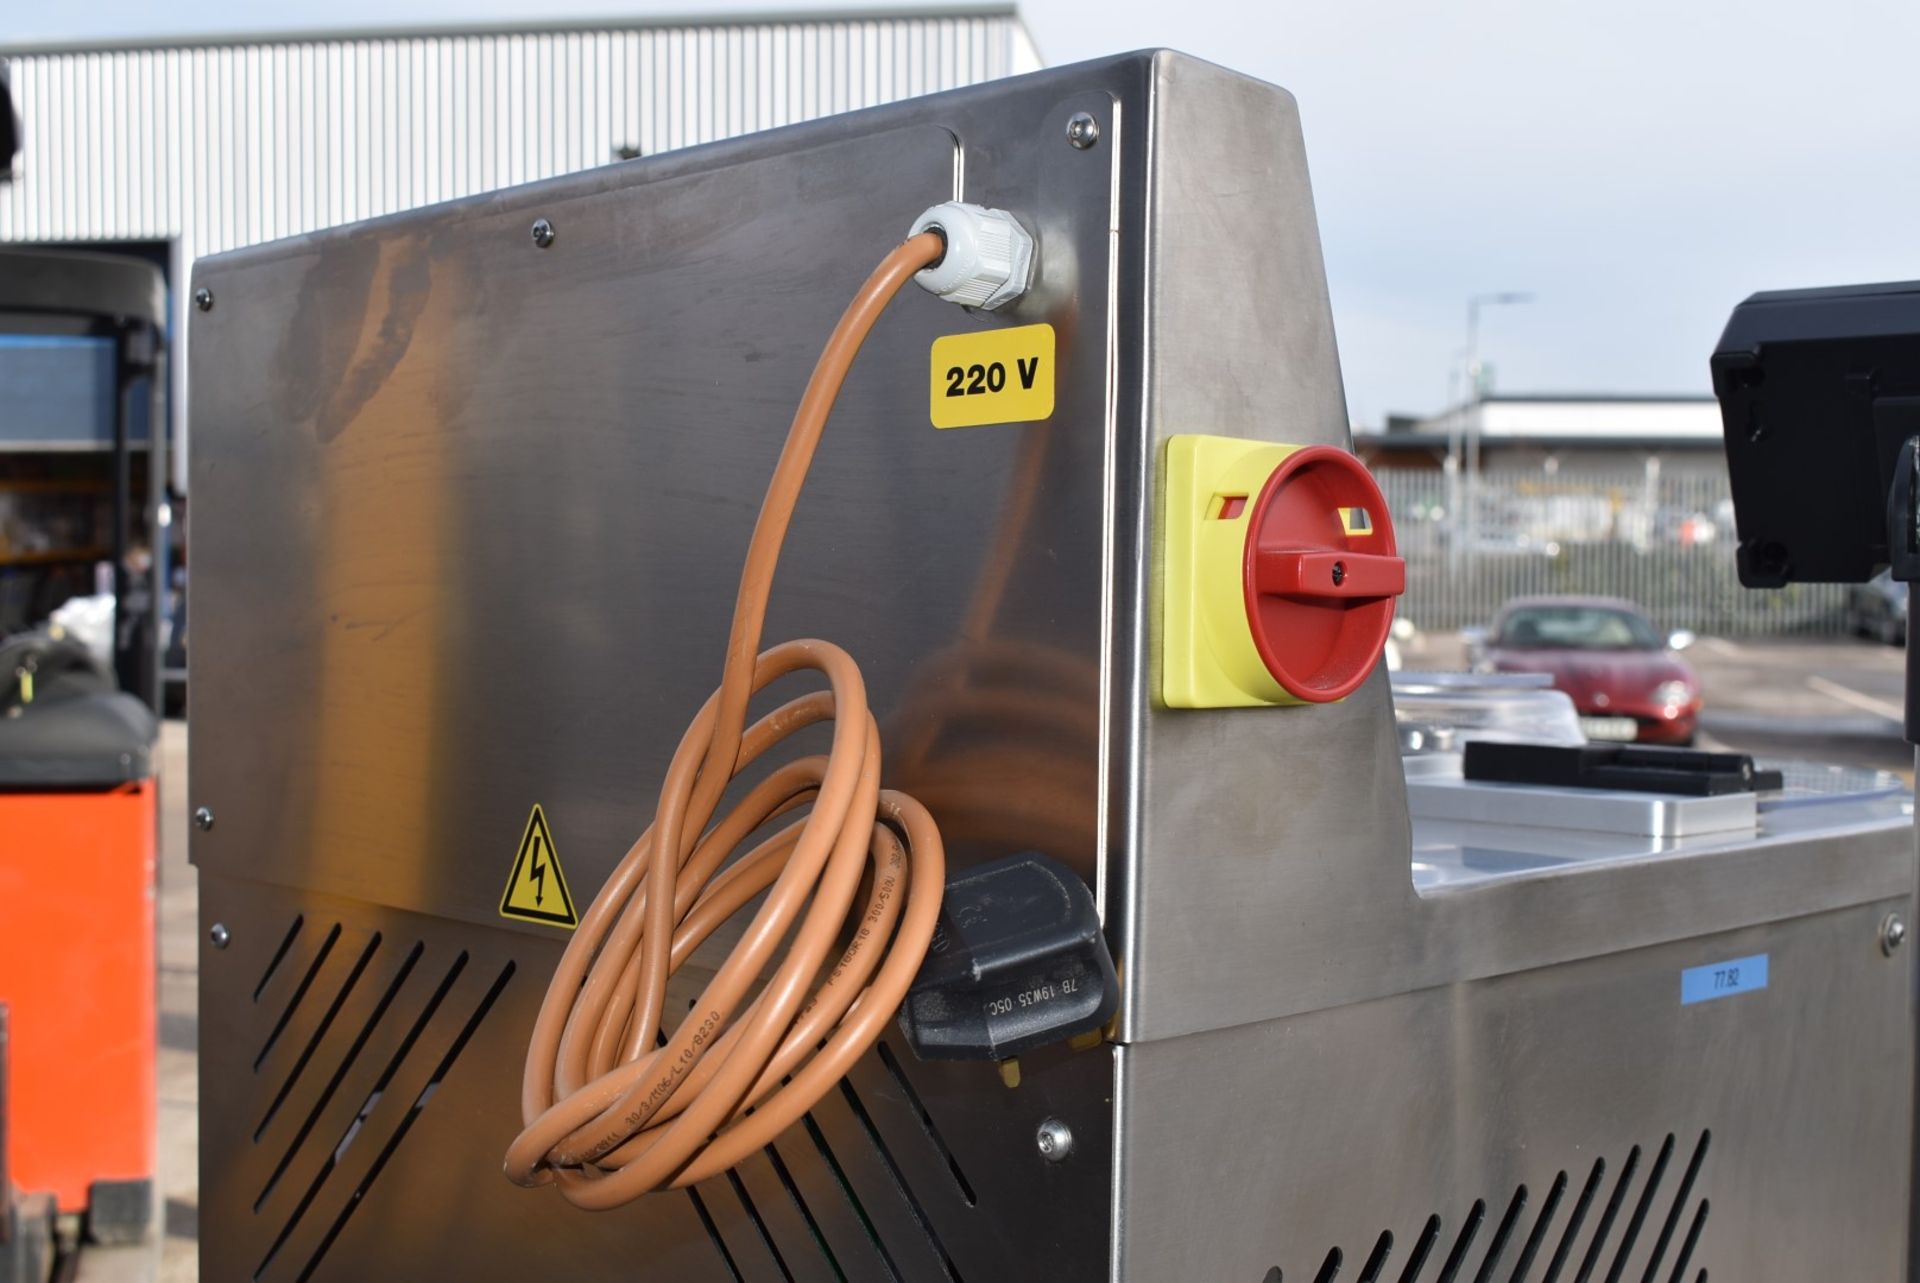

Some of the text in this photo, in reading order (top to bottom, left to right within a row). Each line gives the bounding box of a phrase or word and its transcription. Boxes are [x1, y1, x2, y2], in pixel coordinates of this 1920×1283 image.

[946, 357, 1039, 397] 220 V
[988, 977, 1078, 1016] 7B 19W35 05C
